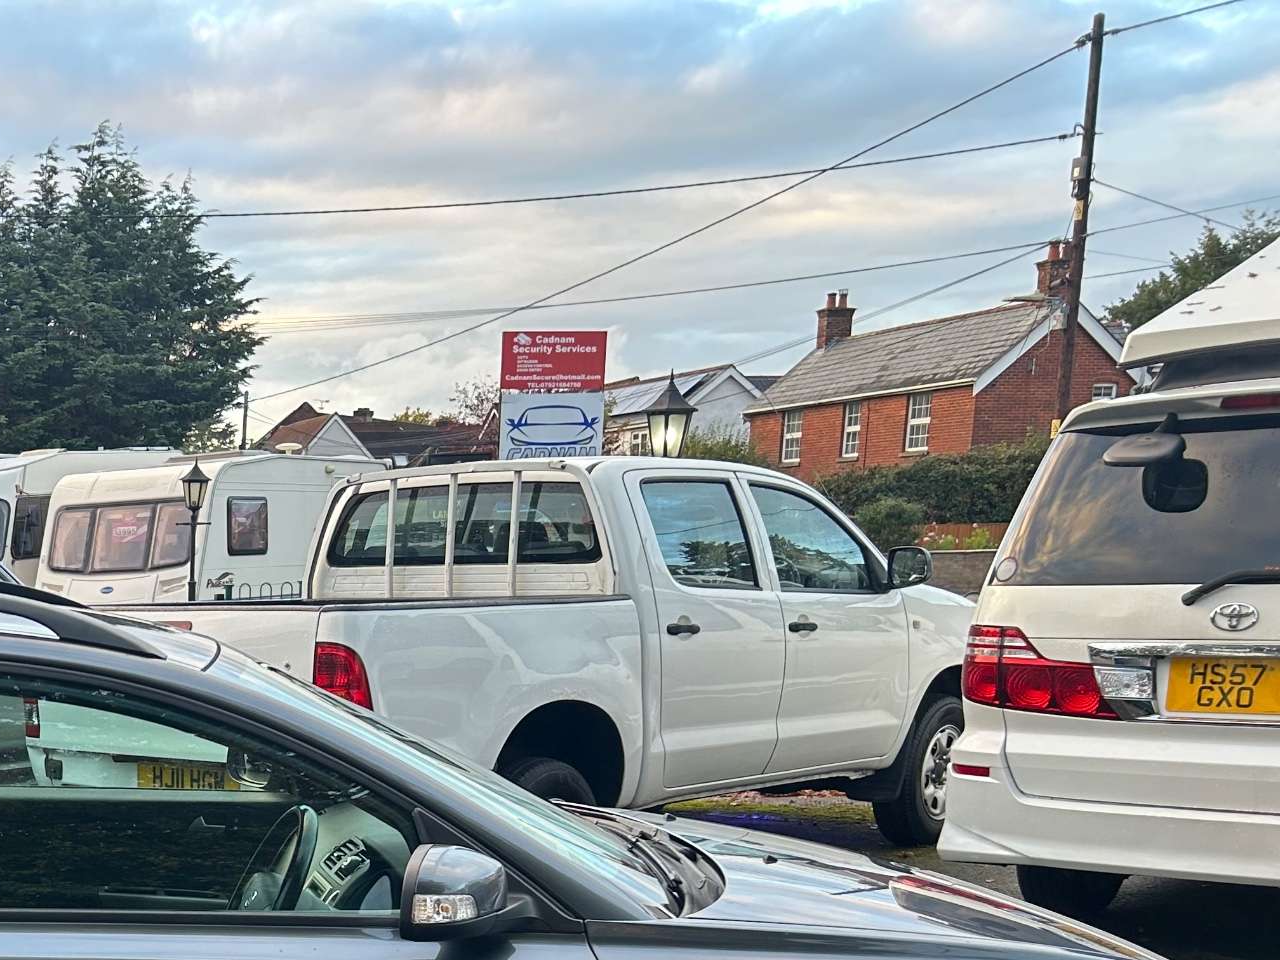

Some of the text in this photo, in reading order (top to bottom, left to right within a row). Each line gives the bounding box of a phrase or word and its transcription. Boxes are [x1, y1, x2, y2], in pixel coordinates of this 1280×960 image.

[535, 335, 575, 344] Cadnam
[512, 344, 597, 355] Security Services
[1190, 663, 1267, 686] HS57
[1196, 686, 1254, 708] GXO
